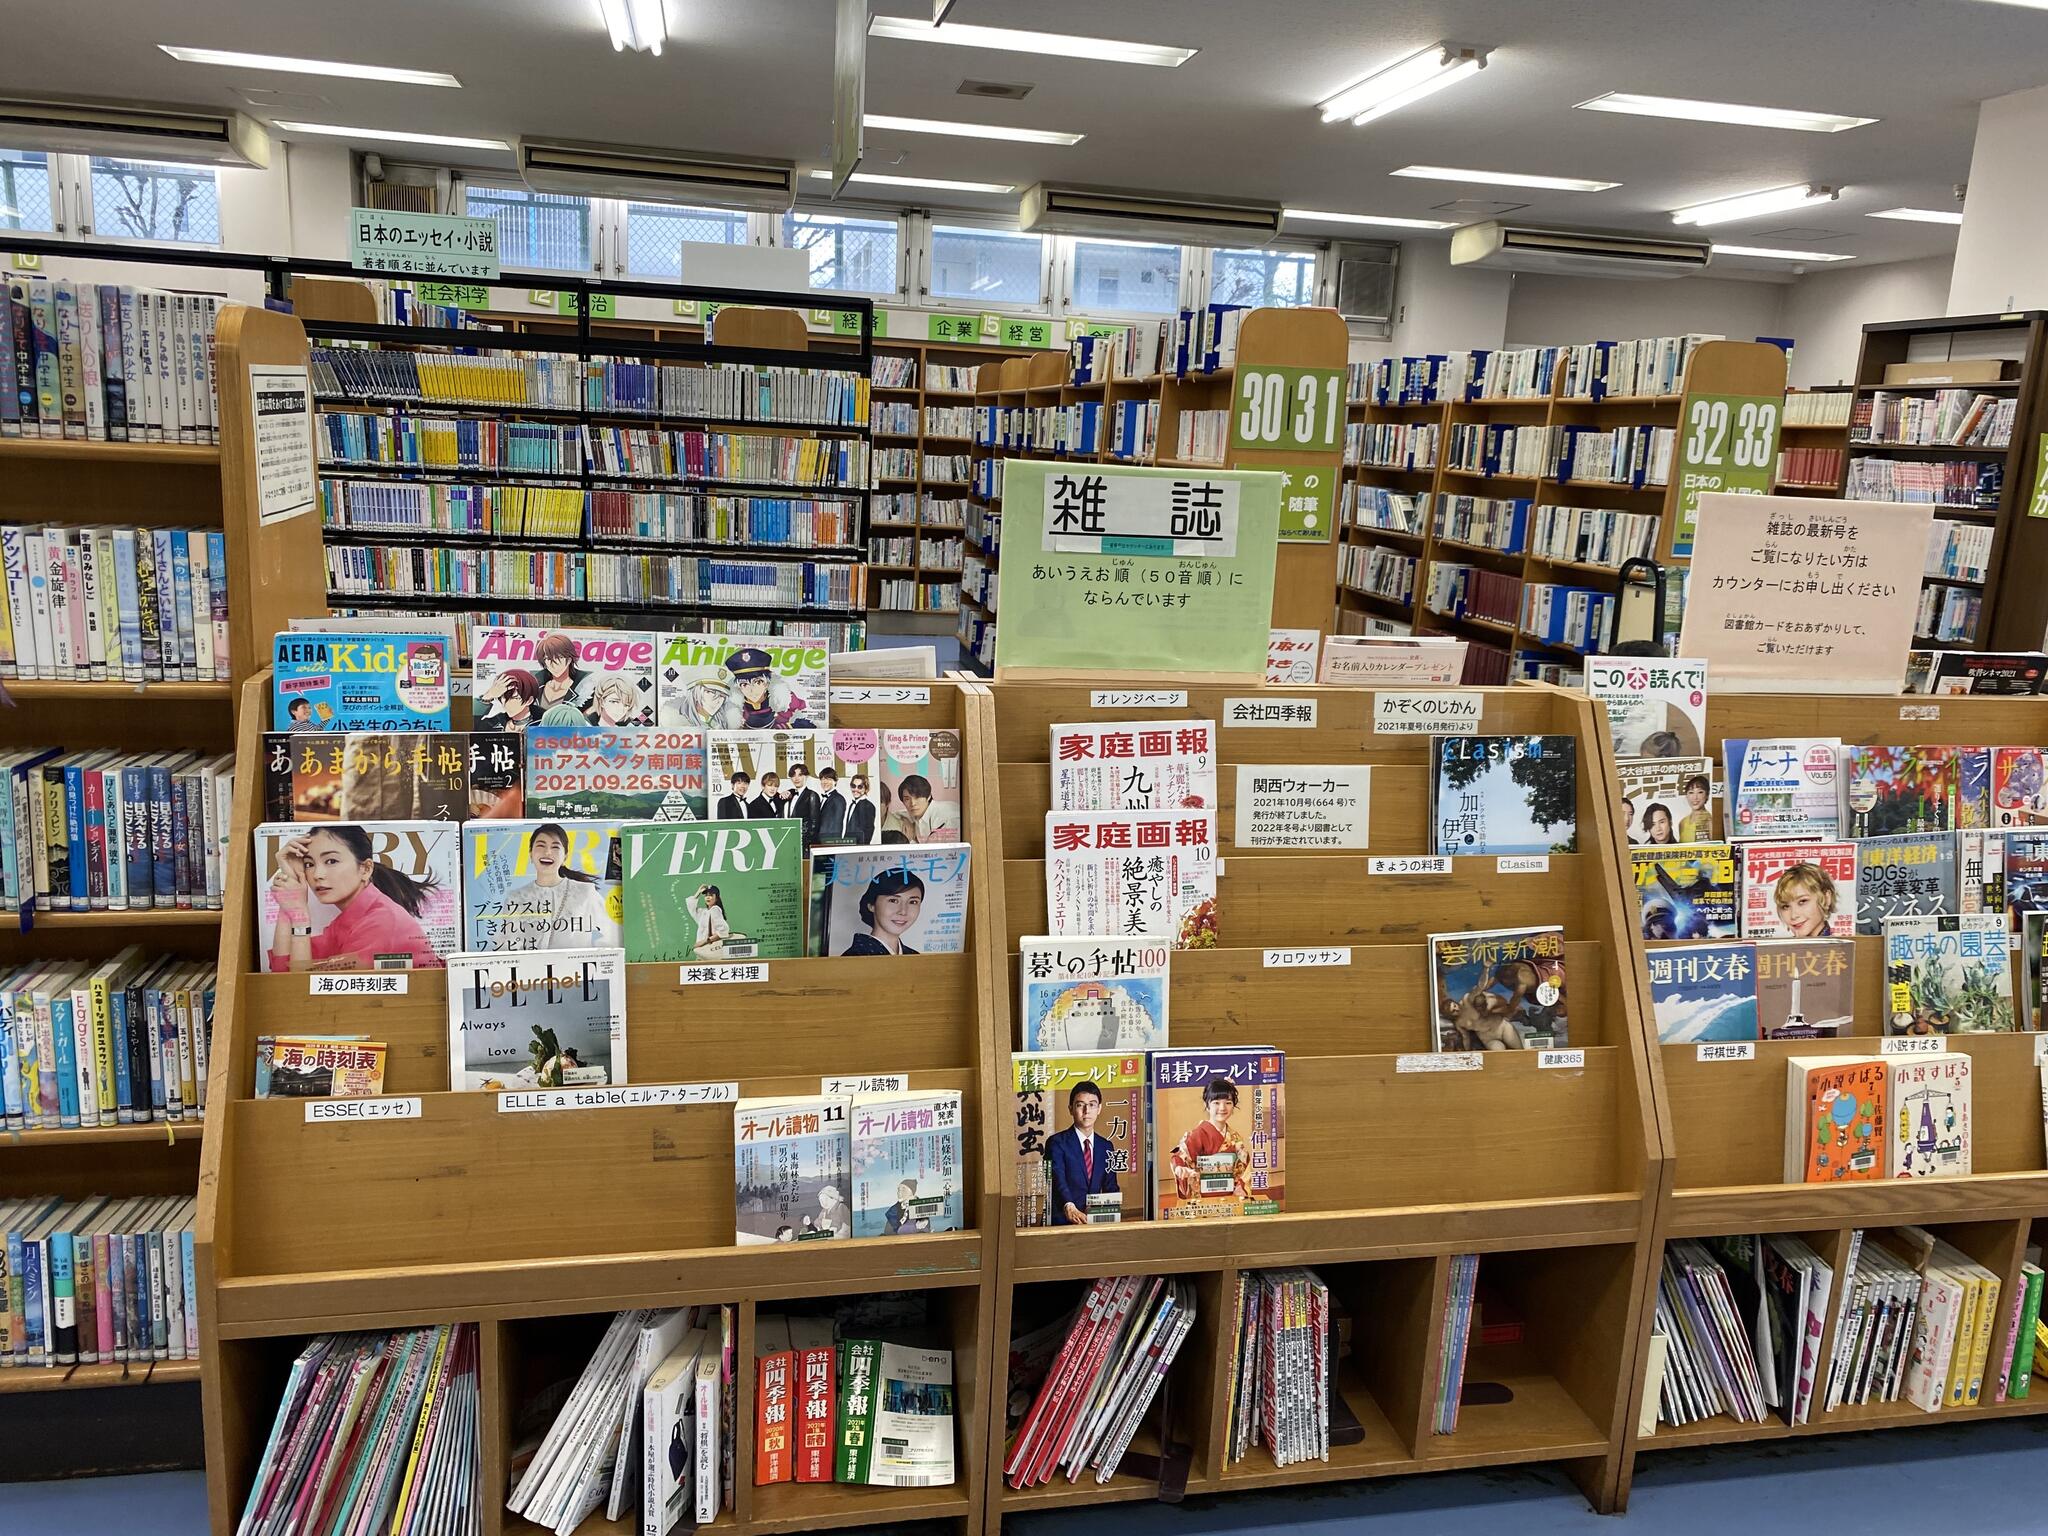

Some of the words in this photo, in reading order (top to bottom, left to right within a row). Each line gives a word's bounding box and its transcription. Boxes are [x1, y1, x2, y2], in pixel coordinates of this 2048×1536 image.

[360, 223, 493, 252] 日本のエッセイ・小説
[362, 257, 491, 277] 著者順名に並んでいます
[420, 284, 488, 304] 社会科学
[937, 320, 972, 337] 企業
[983, 315, 1000, 334] 15
[1009, 325, 1043, 342] 経営
[1068, 320, 1086, 338] 16
[58, 308, 76, 388] なりたて中学生
[1240, 372, 1285, 442] 30
[1294, 375, 1340, 444] 31
[1687, 400, 1729, 465] 32
[1734, 402, 1777, 468] 33
[1684, 473, 1722, 489] 日本の
[1053, 474, 1224, 537] 雑誌
[1766, 520, 1859, 540] 雑誌の最新号を
[2, 530, 22, 596] ダッシュ!
[81, 533, 94, 600] 宇宙のみなしご
[1750, 548, 1868, 568] ご覧になりたい方は
[48, 546, 67, 609] 黄金旋律
[69, 572, 78, 600] カラフル
[156, 537, 173, 632] レイさんといた夏
[1712, 575, 1896, 597] カウンターにお申し出ください
[1084, 590, 1192, 608] ならんでいます
[480, 631, 526, 639] アニメージュ
[1724, 618, 1866, 635] 図書館カードをおあずかりして、
[664, 638, 707, 646] アニメージュ
[1756, 643, 1834, 656] ご覧いただけます
[279, 644, 327, 662] AERA
[296, 660, 327, 672] with
[1331, 661, 1454, 673] お名前入りカレンダープレゼント
[1968, 668, 2017, 678] 吹替シネマ2021
[829, 689, 930, 702] ニメージュ
[1097, 693, 1180, 705] オレンジページ
[1232, 703, 1312, 722] 会社四季報
[1383, 699, 1476, 715] かぞくのじかん
[332, 719, 443, 732] 小学生のうちに
[1377, 722, 1474, 731] 2021年夏号(6月発行)より
[835, 742, 875, 752] 関ジャニ∞
[887, 734, 902, 743] King
[911, 735, 929, 743] Prince
[1059, 728, 1209, 761] 家庭画報
[1442, 737, 1544, 762] CLasism
[271, 745, 293, 776] あ
[300, 745, 464, 777] あまから手帖
[1198, 755, 1207, 770] 9
[449, 777, 463, 791] 10
[505, 775, 513, 789] 2
[534, 774, 704, 791] 2021.09.26.SUN
[712, 783, 722, 793] 10
[1253, 778, 1349, 793] 関西ウォーカー
[50, 790, 61, 837] クリスピン
[1252, 810, 1327, 820] 発行が終了しました。
[134, 801, 148, 850] 見えざる
[159, 801, 173, 849] 見えざる
[1251, 823, 1353, 833] 2022年冬号より図書として
[1053, 818, 1209, 851] 家庭画報
[1251, 836, 1343, 845] 刊行が予定されています。
[1442, 818, 1461, 855] 伊豆
[627, 826, 796, 880] VERY
[1194, 847, 1210, 862] 10
[1631, 848, 1730, 861] 国民健康保険料が高すぎる!
[1869, 845, 1937, 865] 東洋経済
[824, 852, 968, 889] 美しいキモノ
[1375, 859, 1446, 872] きょうの料理
[1500, 861, 1544, 870] CLasism
[1862, 864, 1919, 883] SDGsが
[1147, 855, 1164, 912] 癒やしの
[1122, 856, 1149, 936] 絶景美
[474, 900, 552, 917] ブラウスは
[1856, 893, 1949, 924] ビジネス
[476, 915, 602, 937] 「きれいめの日」、
[1995, 918, 2003, 927] 9
[476, 937, 538, 952] ワンピは
[1441, 935, 1560, 966] 芸術新潮
[1890, 930, 2007, 960] 趣味の園芸
[1028, 948, 1137, 979] 暮しの手帖
[1136, 948, 1166, 968] 100
[1270, 951, 1342, 965] クロワッサン
[687, 966, 759, 982] 栄養と料理
[1648, 952, 1751, 985] 週刊文春
[318, 976, 398, 992] 海の時刻表
[472, 961, 600, 1010] ELLE
[490, 971, 582, 998] gourmet
[76, 995, 87, 1047] Eggs
[460, 1021, 506, 1032] Always
[488, 1047, 517, 1057] Love
[1704, 1046, 1748, 1059] 将棋世界
[1887, 1039, 1940, 1052] 小説すばる
[283, 1047, 377, 1071] 海の時刻表
[1126, 1060, 1134, 1069] 6
[1267, 1058, 1273, 1067] 1
[1544, 1053, 1582, 1064] 健康365
[1018, 1065, 1028, 1087] 月刊
[1030, 1063, 1118, 1087] 碁ワールド
[1160, 1063, 1171, 1084] 月刊
[1171, 1060, 1259, 1083] 碁ワールド
[1820, 1065, 1884, 1091] 小説すばる
[1897, 1061, 1969, 1084] 小説すばる
[829, 1077, 900, 1093] オール読物
[1868, 1082, 1874, 1091] 7
[313, 1100, 412, 1118] ESSE(エッセ)
[505, 1095, 547, 1109] ELLE
[555, 1097, 566, 1106] a
[934, 1100, 958, 1112] 直木賞
[1254, 1089, 1263, 1129] 最年少棋士
[823, 1105, 846, 1122] 11
[857, 1109, 933, 1136] オール讀物
[938, 1110, 955, 1120] 発表
[741, 1113, 820, 1141] オール讀物
[1874, 1105, 1884, 1143] 佐藤賢一
[1105, 1098, 1129, 1174] 一力遼
[1250, 1131, 1269, 1190] 仲邑菫
[790, 1154, 800, 1203] 東海林さだお
[25, 1246, 38, 1301] 月にハミング
[806, 1351, 829, 1362] 会社
[851, 1345, 874, 1356] 会社
[766, 1357, 786, 1369] 会社
[806, 1362, 829, 1419] 四季報
[846, 1356, 872, 1416] 四季報
[765, 1369, 786, 1425] 四季報
[768, 1438, 781, 1450] 秋
[806, 1433, 825, 1447] 新春
[849, 1432, 861, 1446] 春
[701, 1508, 708, 1516] 2
[646, 1524, 657, 1533] 12
